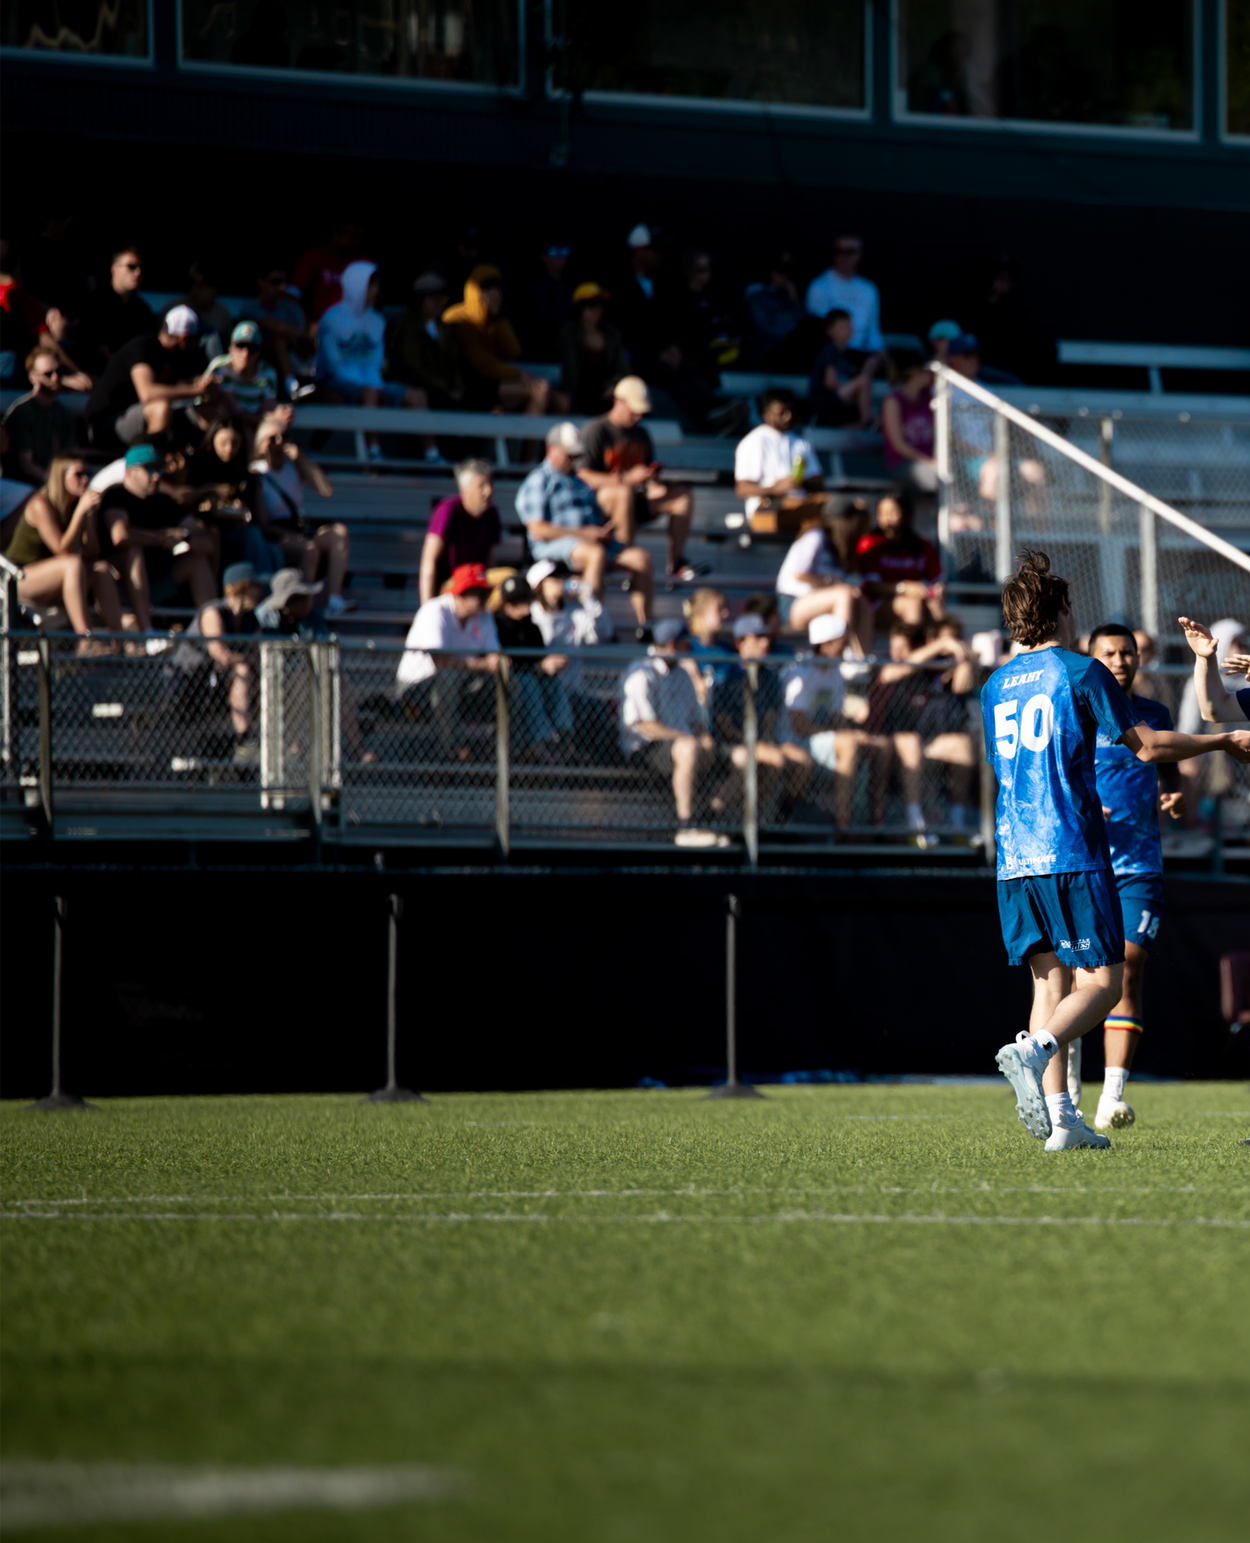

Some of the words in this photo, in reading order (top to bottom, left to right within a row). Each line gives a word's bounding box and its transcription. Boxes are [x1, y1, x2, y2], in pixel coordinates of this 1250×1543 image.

[1002, 669, 1045, 690] LEAHY
[994, 693, 1054, 759] 50
[1018, 854, 1057, 866] ULTIMATE
